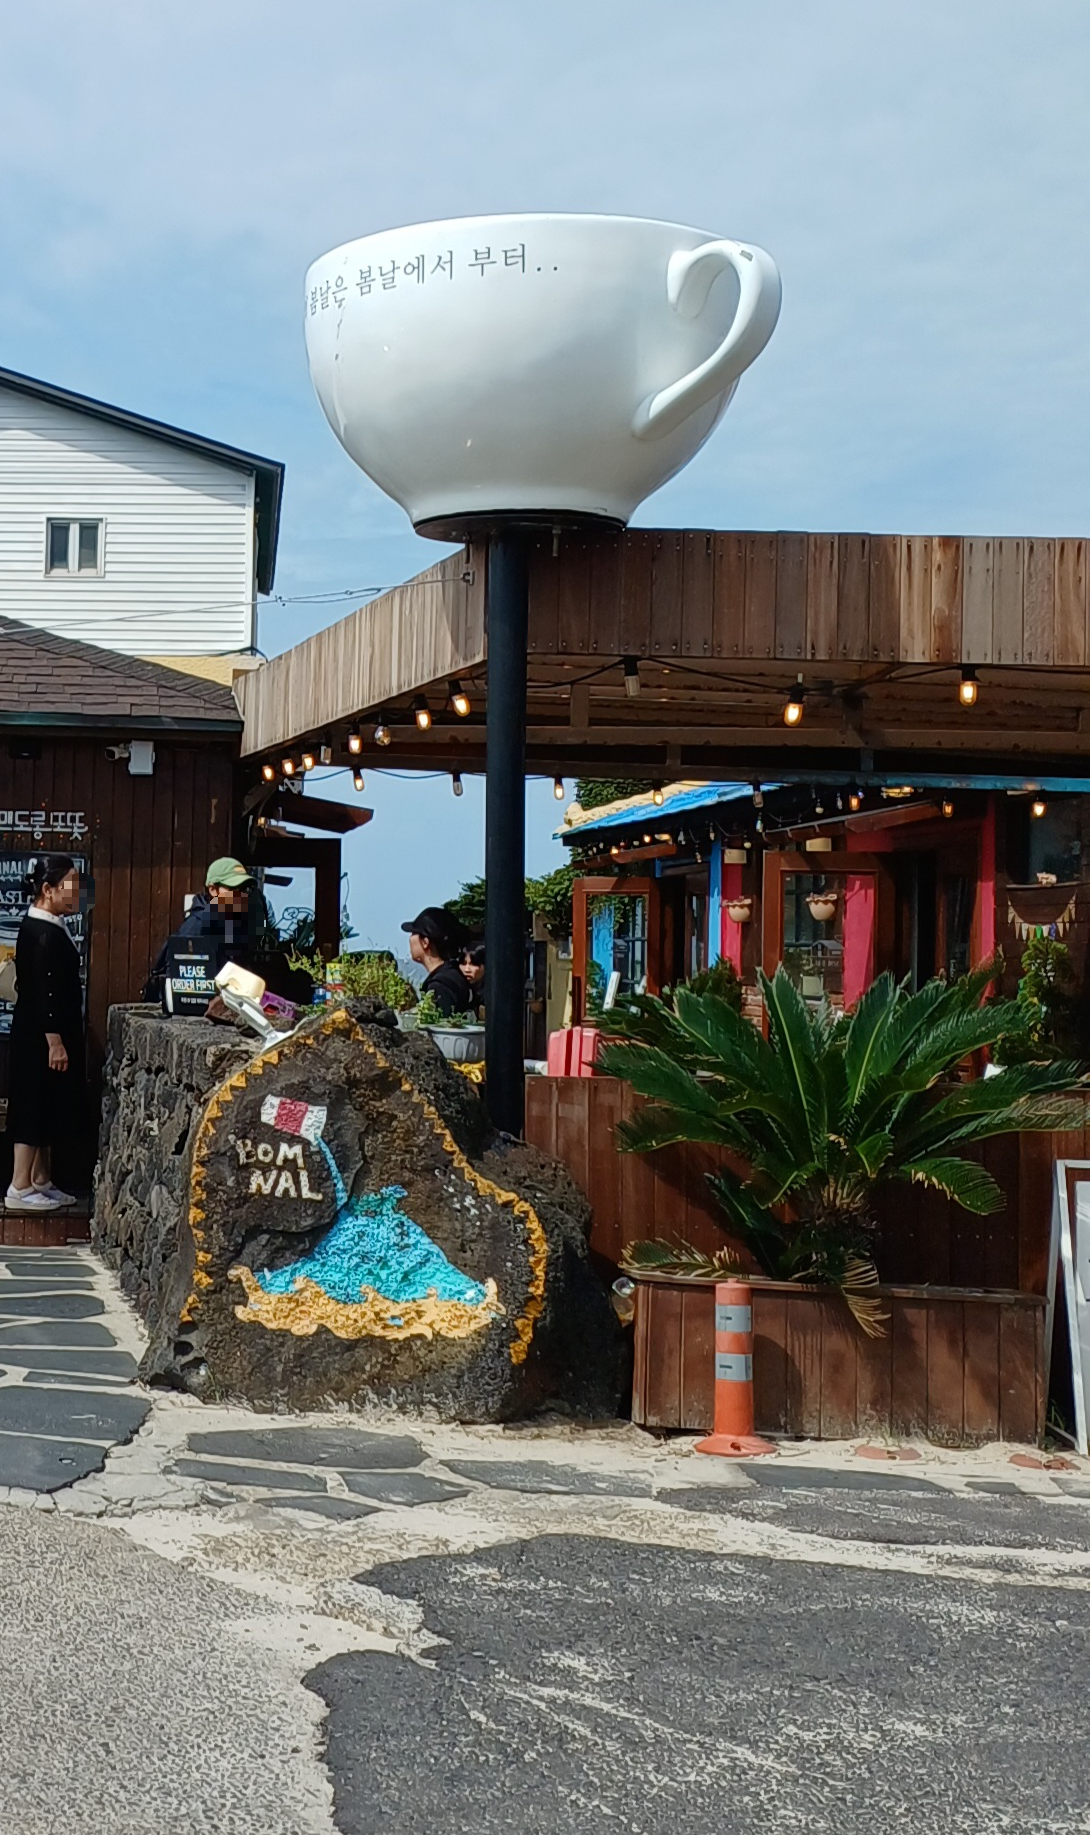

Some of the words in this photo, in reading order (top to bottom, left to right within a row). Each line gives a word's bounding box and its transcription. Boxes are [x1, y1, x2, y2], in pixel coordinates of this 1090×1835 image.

[355, 250, 454, 297] 봄날에서
[171, 977, 194, 991] ORDER
[195, 978, 216, 991] FIRST
[178, 964, 206, 978] PLEASE
[232, 1138, 306, 1168] BOM
[247, 1167, 324, 1201] NAL
